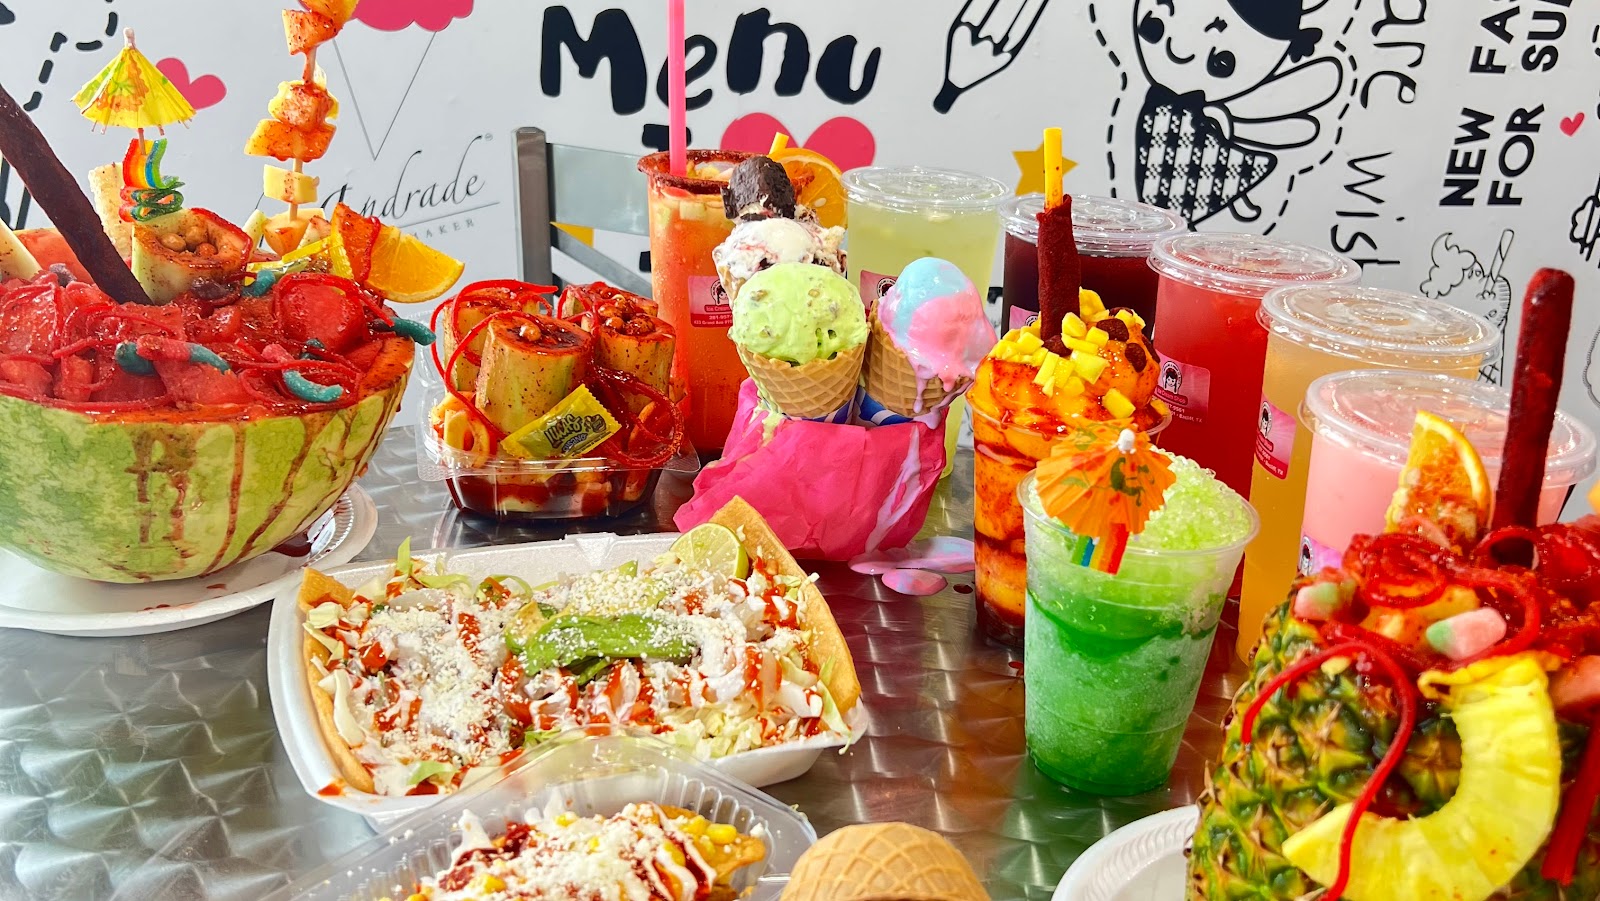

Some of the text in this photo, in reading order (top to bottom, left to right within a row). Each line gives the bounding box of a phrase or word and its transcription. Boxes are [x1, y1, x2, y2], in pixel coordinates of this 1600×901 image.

[540, 5, 881, 116] Menu
[1438, 0, 1521, 207] NEW FA
[1486, 0, 1573, 206] FOR SU
[544, 413, 584, 449] LUCAS
